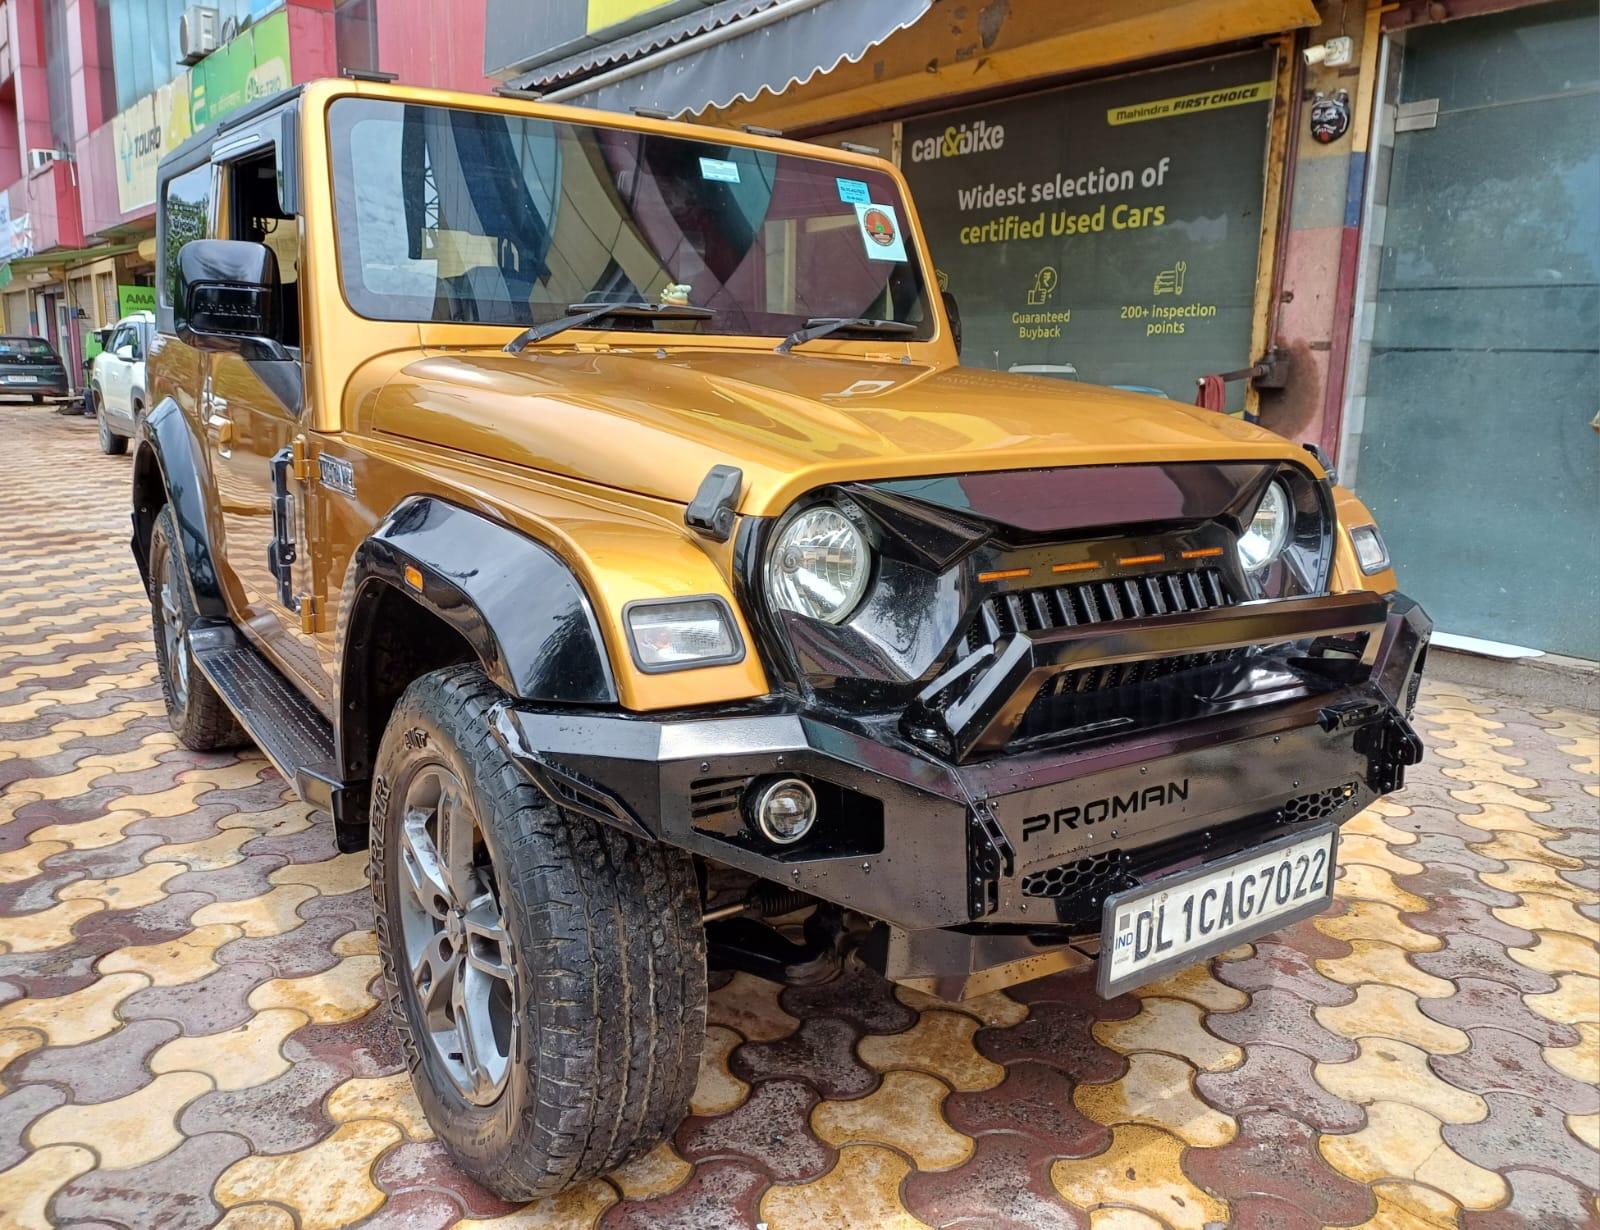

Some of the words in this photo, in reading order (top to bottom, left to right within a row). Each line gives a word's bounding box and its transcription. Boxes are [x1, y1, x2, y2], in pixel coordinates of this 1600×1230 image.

[1116, 104, 1169, 120] Mahindra
[1173, 97, 1210, 111] FIRST
[1211, 87, 1259, 104] CHOICE
[958, 182, 1026, 211] Widest
[1031, 167, 1134, 202] selection
[1141, 157, 1170, 188] of
[960, 211, 1045, 245] certified
[1051, 204, 1105, 236] Used
[1112, 204, 1166, 231] Cars
[1012, 309, 1070, 324] Guaranteed
[1120, 305, 1149, 319] 200+
[1152, 304, 1216, 320] inspection
[1019, 325, 1060, 340] Buyback
[1146, 322, 1185, 337] points
[1022, 779, 1188, 842] PROMAN
[1115, 932, 1134, 950] IND
